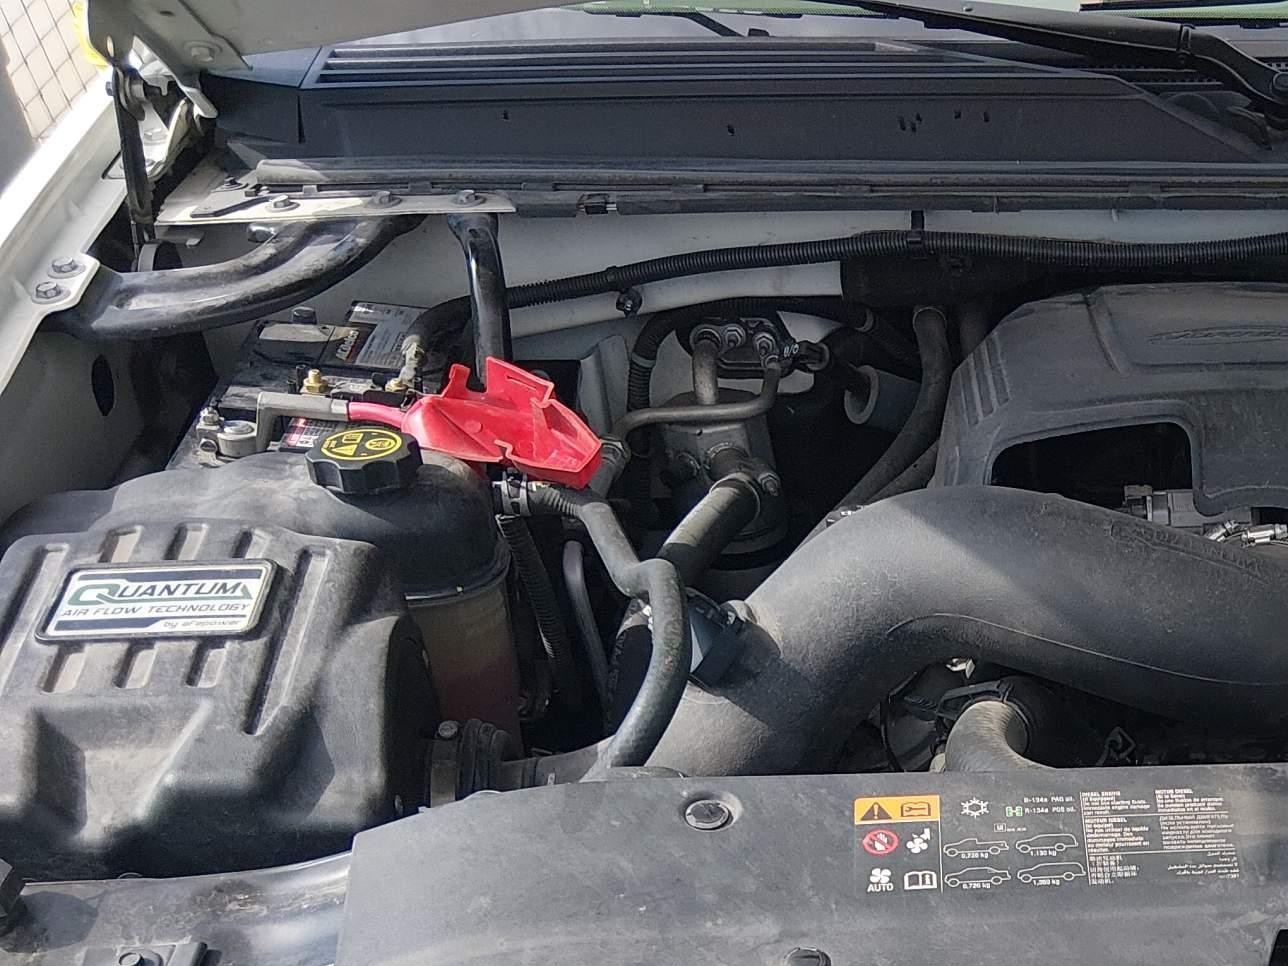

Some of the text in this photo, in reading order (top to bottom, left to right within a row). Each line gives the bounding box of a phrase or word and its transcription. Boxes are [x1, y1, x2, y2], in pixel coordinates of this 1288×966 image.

[67, 581, 243, 606] QUANTUM
[61, 603, 251, 617] AIR FLOW TECHNOLOGY
[867, 883, 894, 893] AUTO
